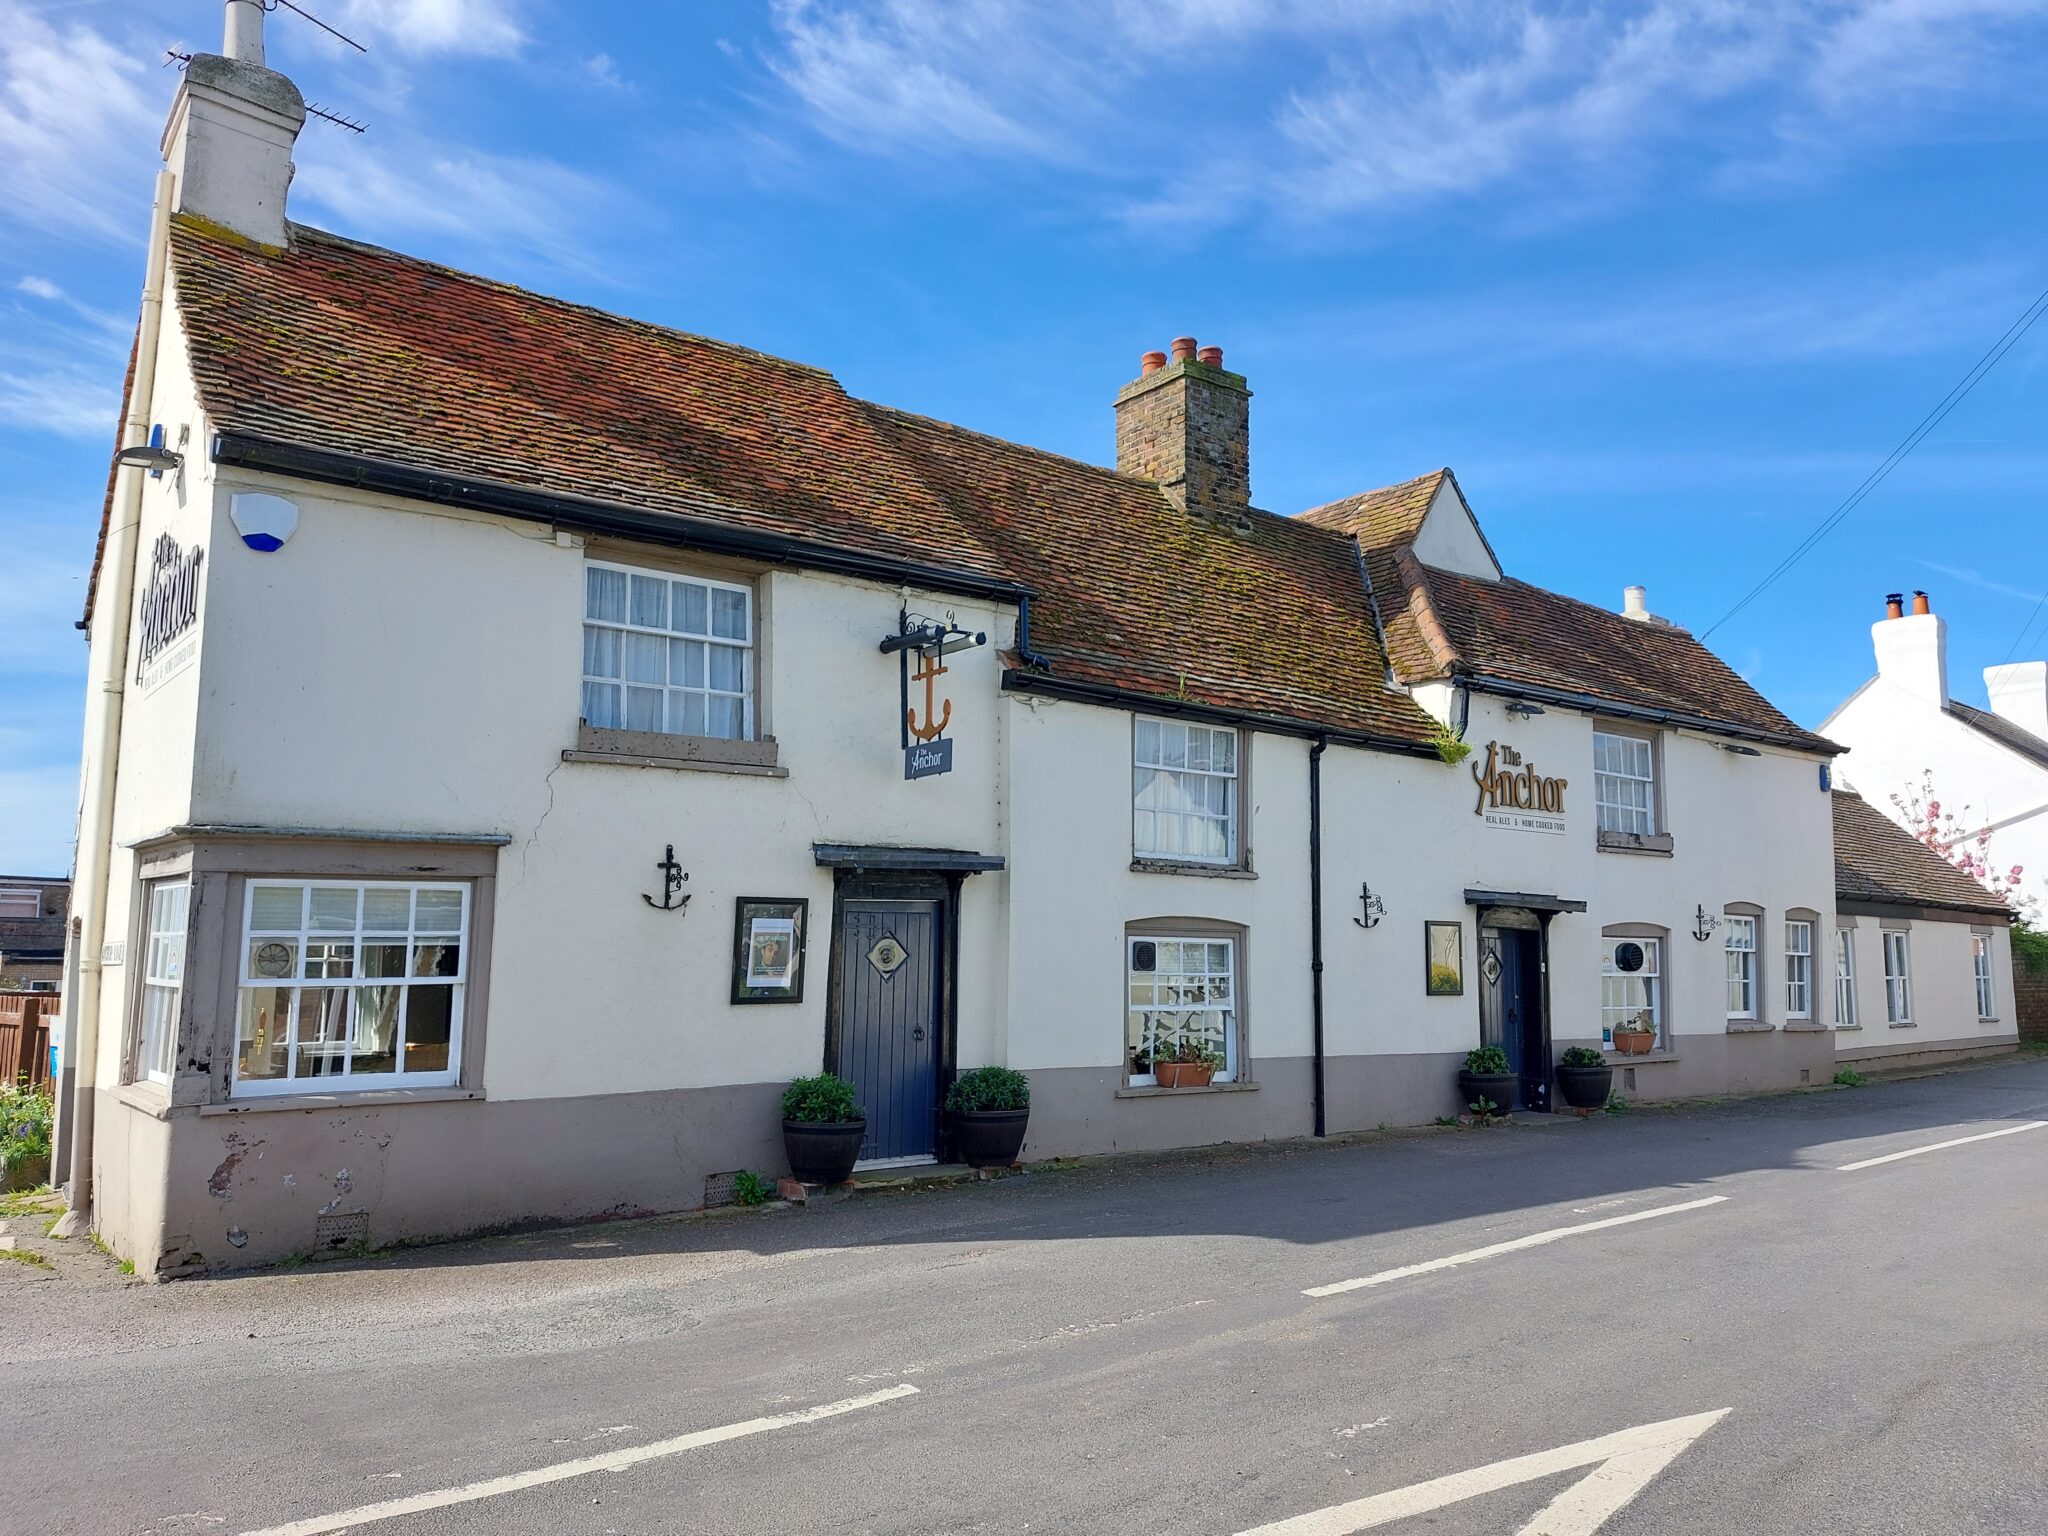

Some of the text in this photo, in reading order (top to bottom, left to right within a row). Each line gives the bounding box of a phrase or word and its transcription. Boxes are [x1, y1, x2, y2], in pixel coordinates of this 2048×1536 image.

[912, 749, 942, 774] Anchor
[1501, 745, 1522, 766] The
[1472, 740, 1568, 816] Anchor
[1486, 816, 1498, 824] REAL
[1498, 817, 1511, 826] ALES
[1521, 819, 1535, 828] HOME
[1535, 820, 1553, 830] COOKED
[1554, 822, 1565, 831] FOOD
